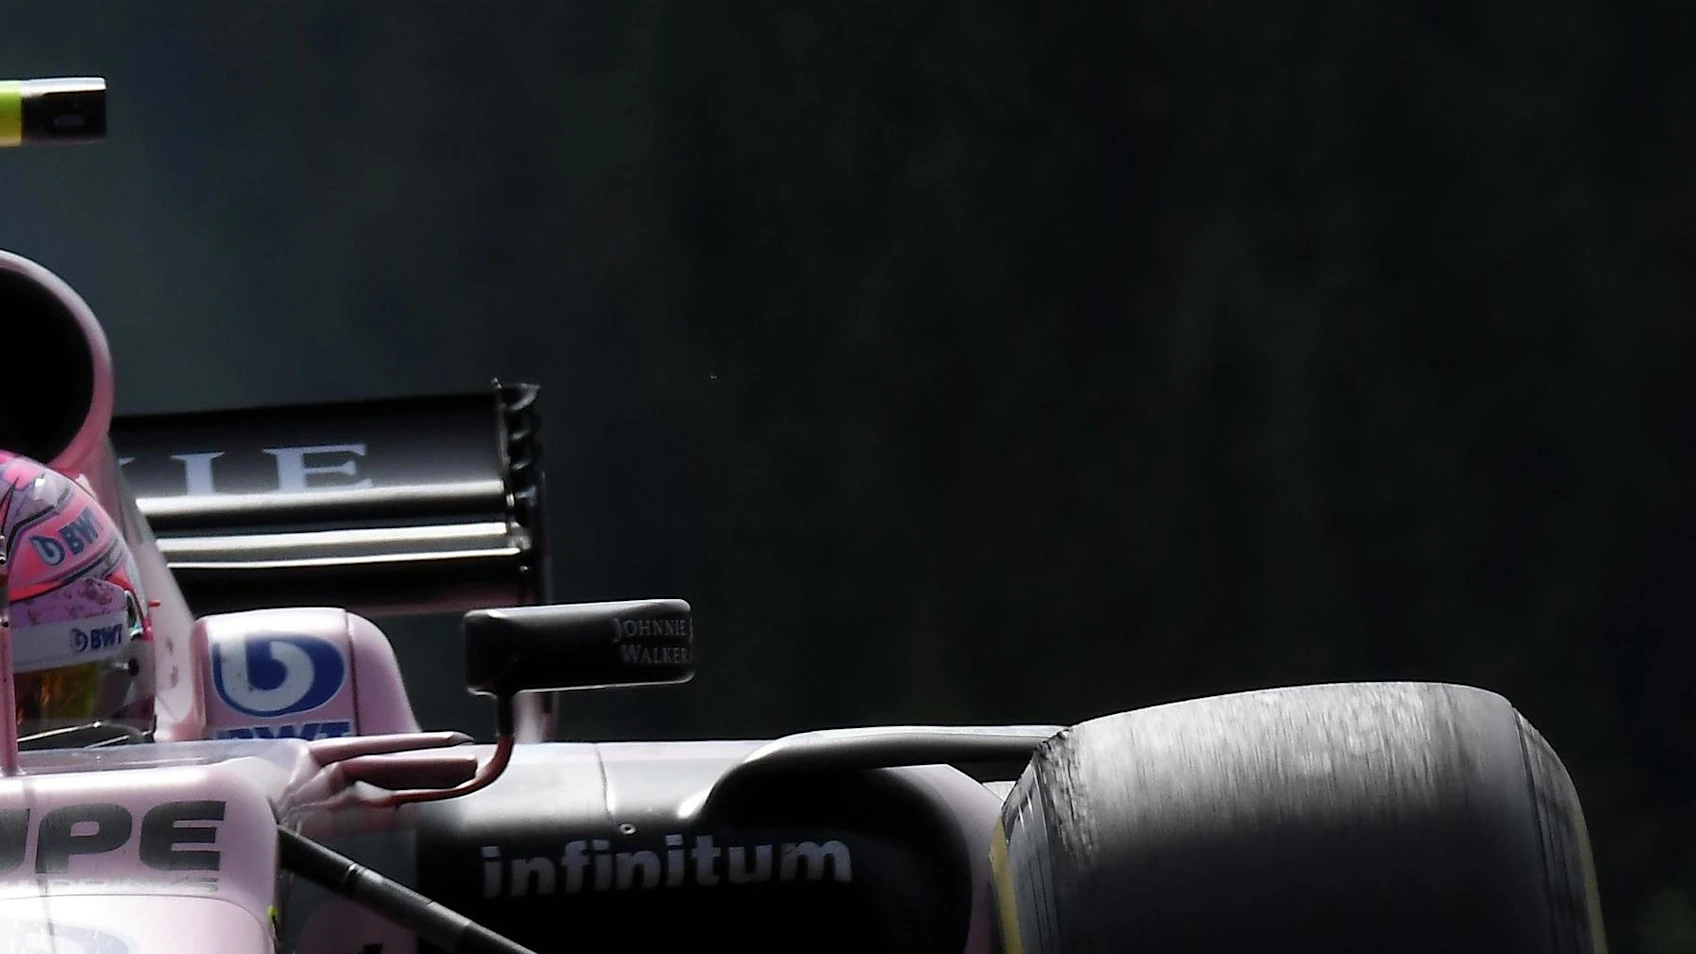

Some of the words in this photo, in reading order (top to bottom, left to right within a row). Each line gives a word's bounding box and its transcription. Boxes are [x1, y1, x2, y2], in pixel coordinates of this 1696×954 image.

[612, 617, 688, 643] JOHNNIE
[618, 642, 691, 666] WALKER
[479, 832, 854, 900] infinitum
